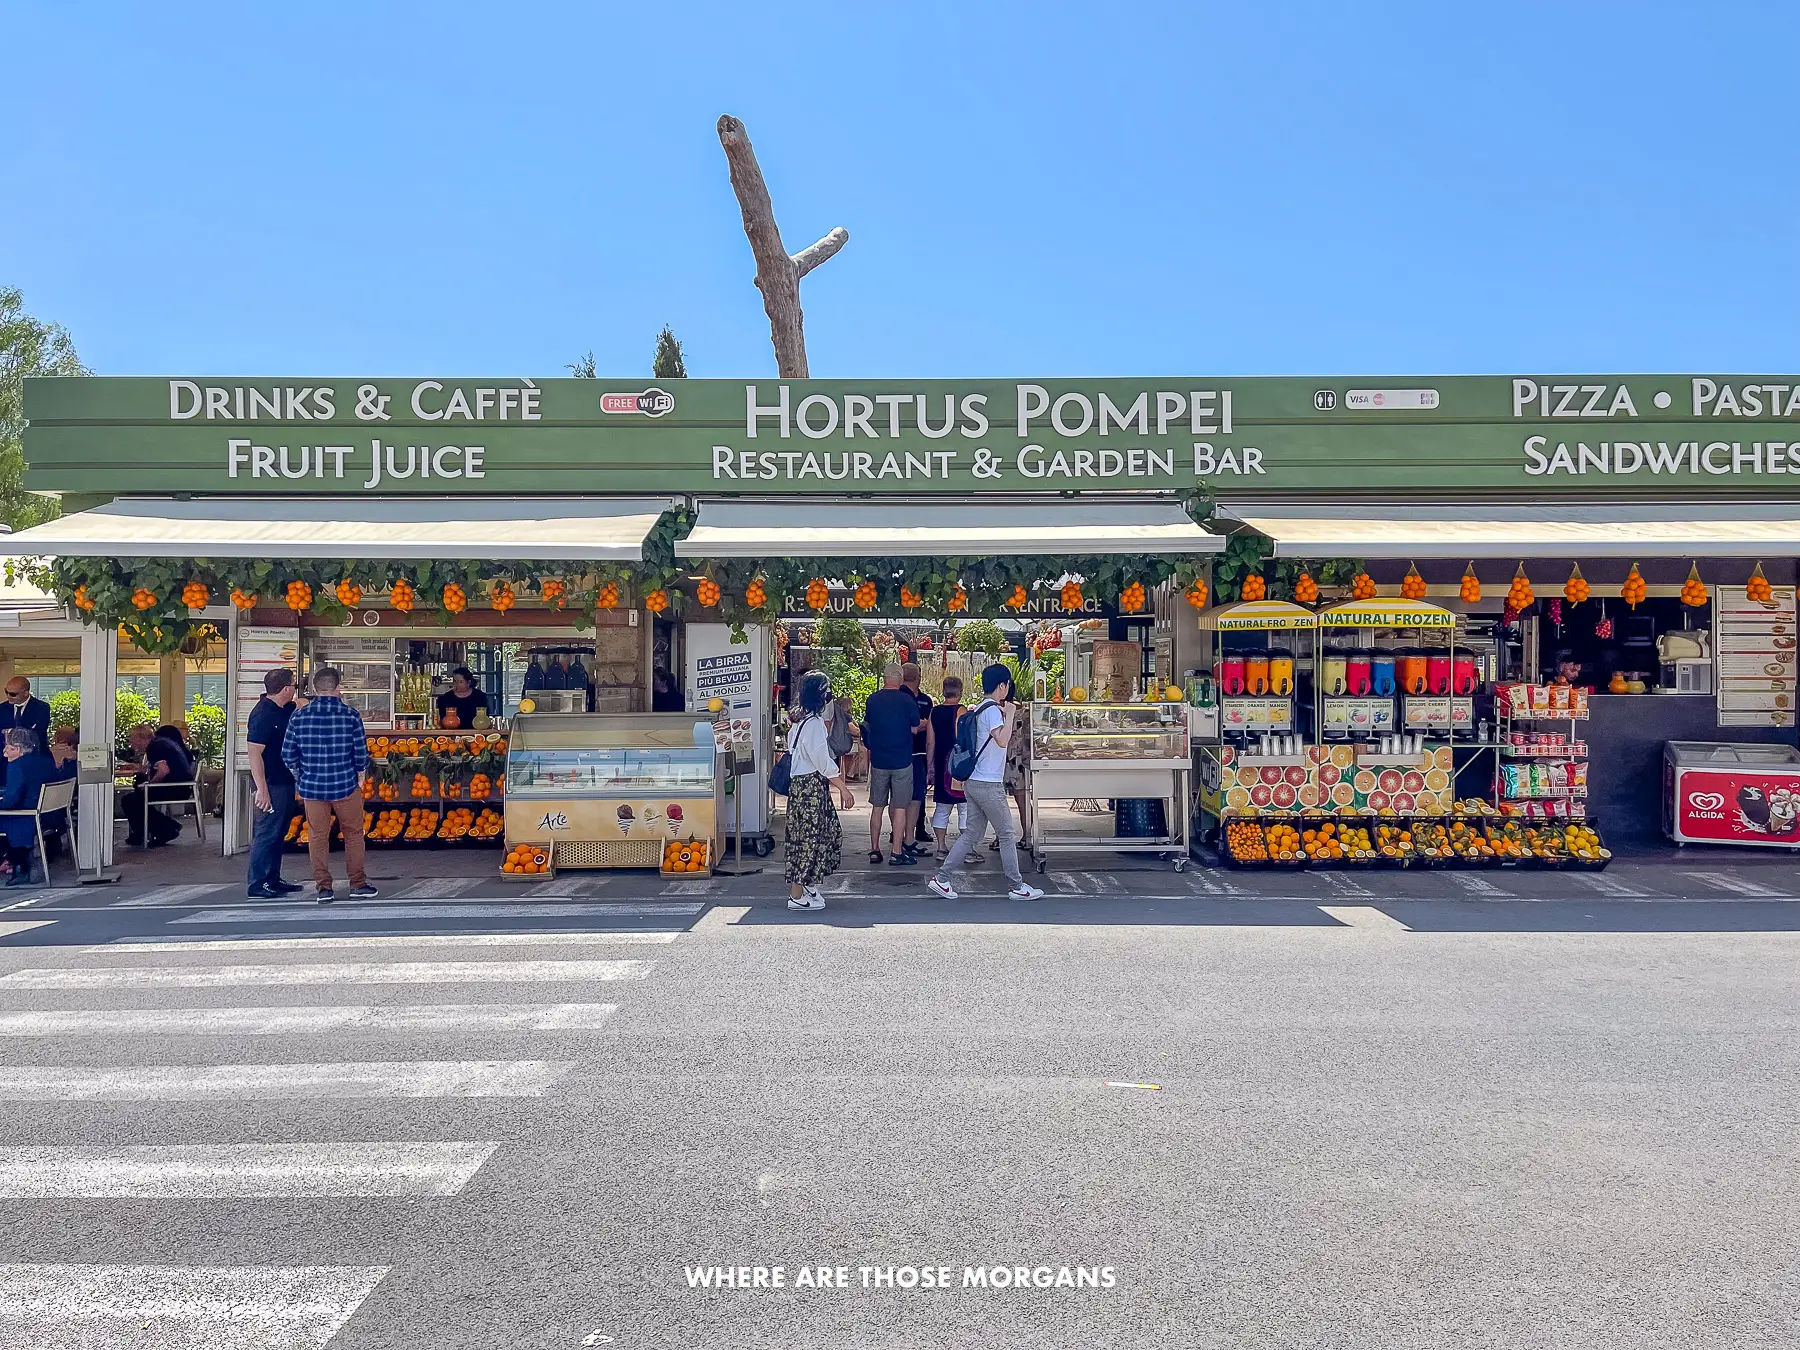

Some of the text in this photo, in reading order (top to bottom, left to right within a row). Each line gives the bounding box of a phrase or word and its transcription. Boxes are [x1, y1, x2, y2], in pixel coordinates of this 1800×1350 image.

[170, 378, 541, 420] DRINKS & CAFFÈ
[608, 398, 633, 408] FREE
[1349, 395, 1369, 403] VISA
[1513, 379, 1800, 417] PIZZA PASTA
[746, 384, 1232, 439] HORTUS POMPEI
[713, 442, 1267, 479] RESTAURANT & GARDEN BAR
[1524, 436, 1800, 475] SANDWICHES
[229, 439, 485, 489] FRUIT JUICE
[1219, 619, 1266, 629] NATURAL
[1323, 613, 1451, 625] NATURAL FROZEN
[699, 654, 749, 669] LA BIRRA
[698, 665, 750, 677] PREMIUM ITALIANA
[715, 673, 750, 684] BEVUTA
[699, 690, 711, 698] AL
[1688, 811, 1724, 819] ALGIDA
